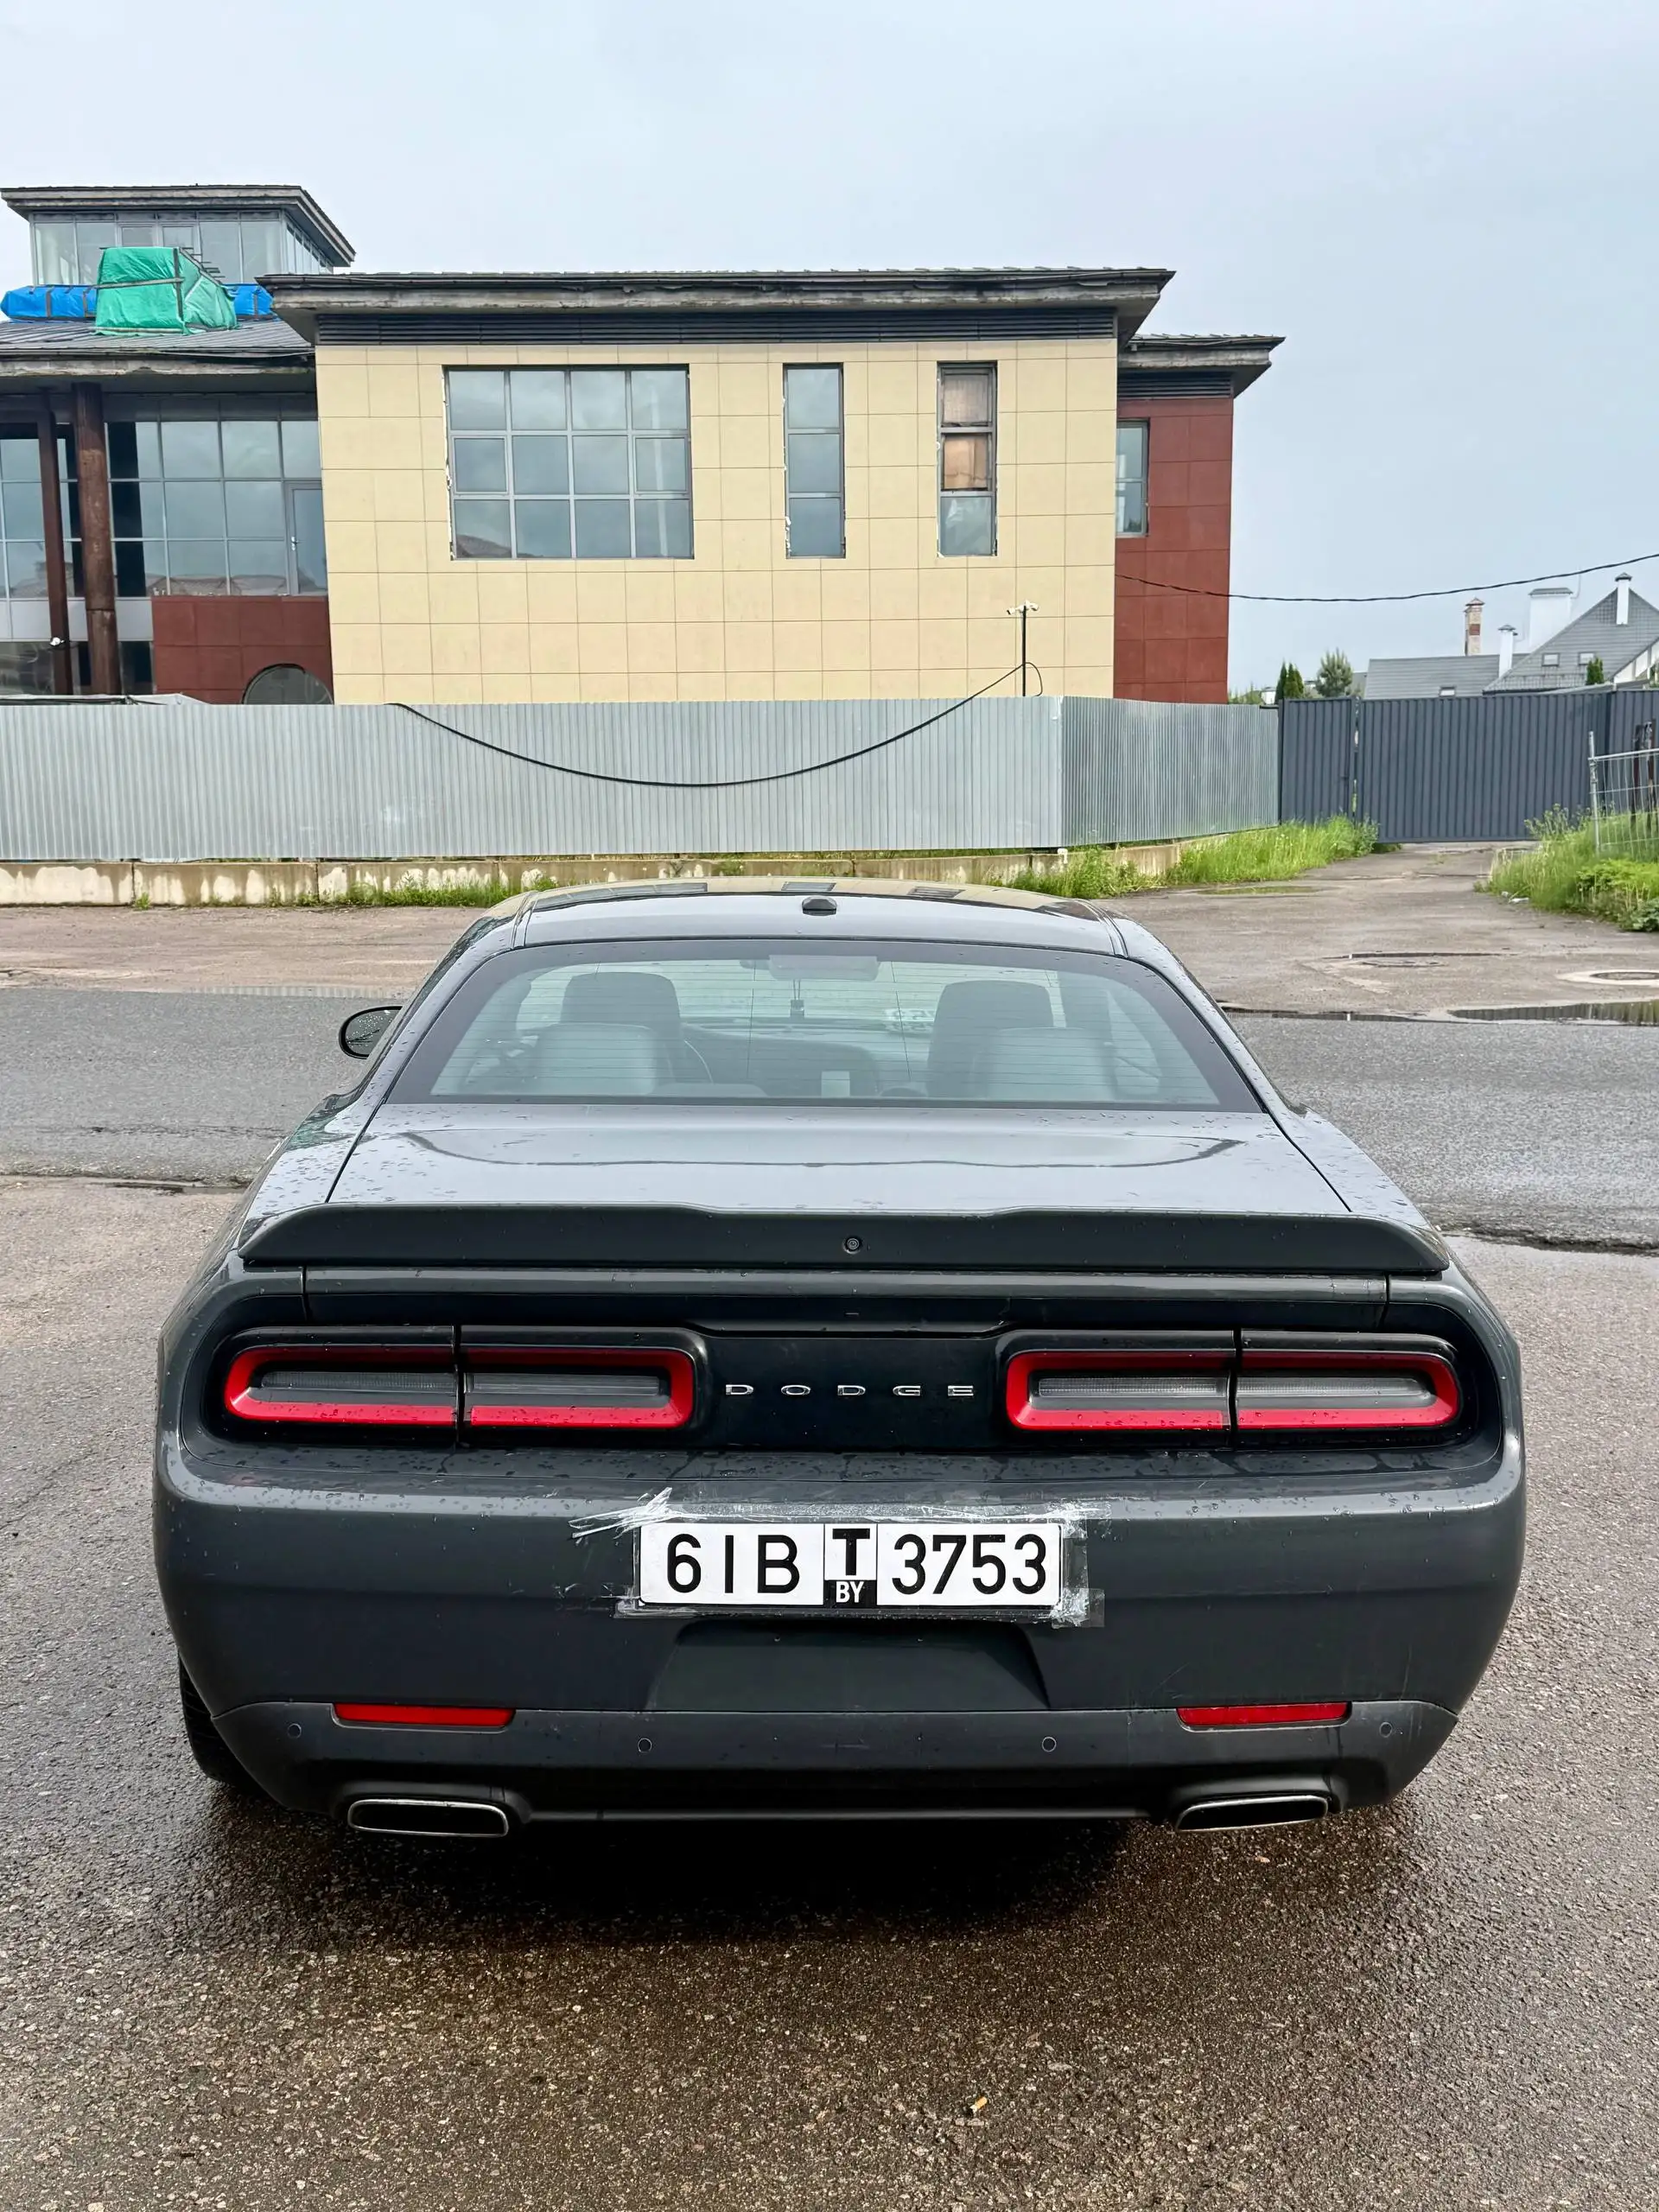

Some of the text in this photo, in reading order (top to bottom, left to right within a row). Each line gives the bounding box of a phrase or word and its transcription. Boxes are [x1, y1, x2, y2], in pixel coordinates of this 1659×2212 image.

[725, 1384, 975, 1396] DODGE
[832, 1528, 871, 1576] T
[892, 1533, 1046, 1595] 3753
[836, 1580, 865, 1603] BY
